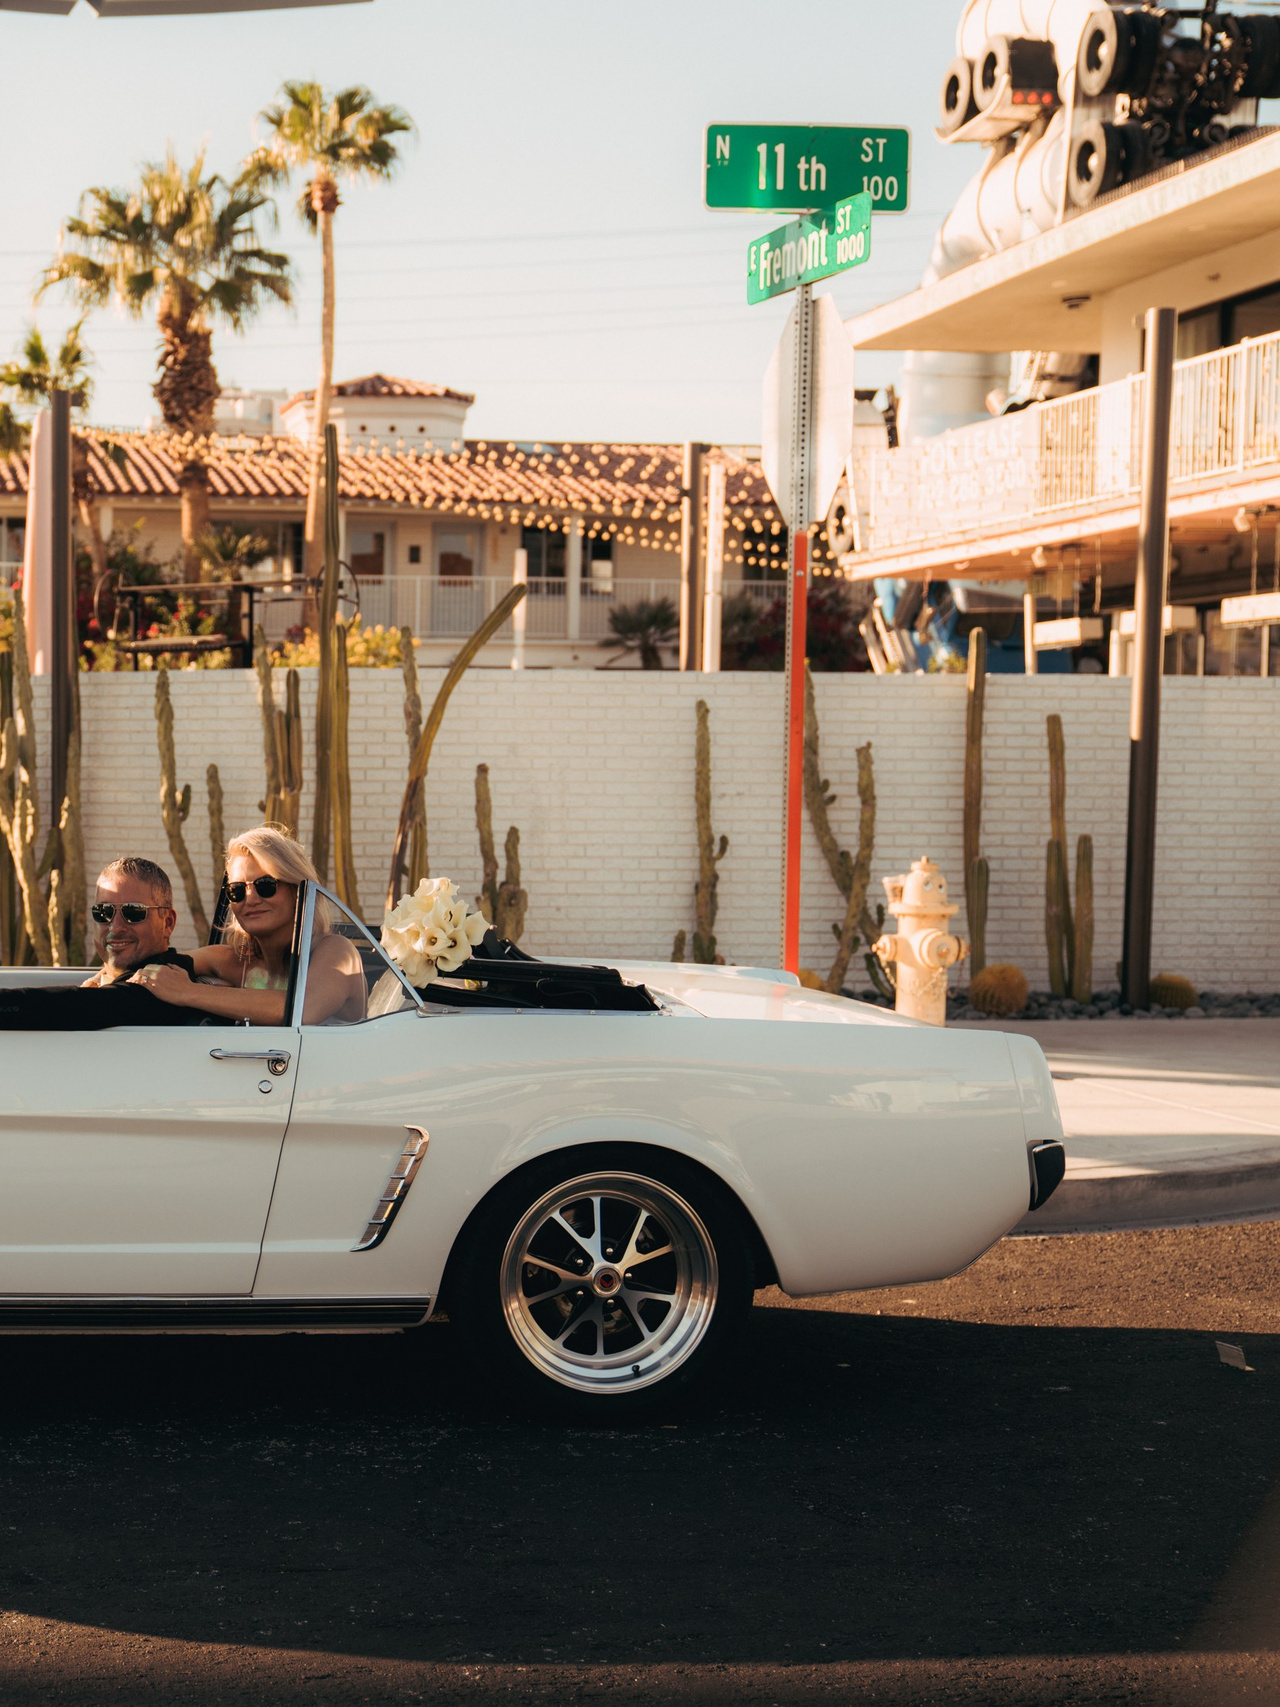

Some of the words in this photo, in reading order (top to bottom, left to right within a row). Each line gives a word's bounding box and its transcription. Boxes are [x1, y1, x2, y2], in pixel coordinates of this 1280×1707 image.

[716, 134, 730, 160] N
[860, 137, 888, 163] ST
[862, 175, 898, 201] 100
[750, 244, 757, 271] E
[759, 218, 828, 291] Fremont
[836, 204, 852, 235] ST
[836, 231, 865, 265] 1000
[963, 418, 1023, 467] LEASE
